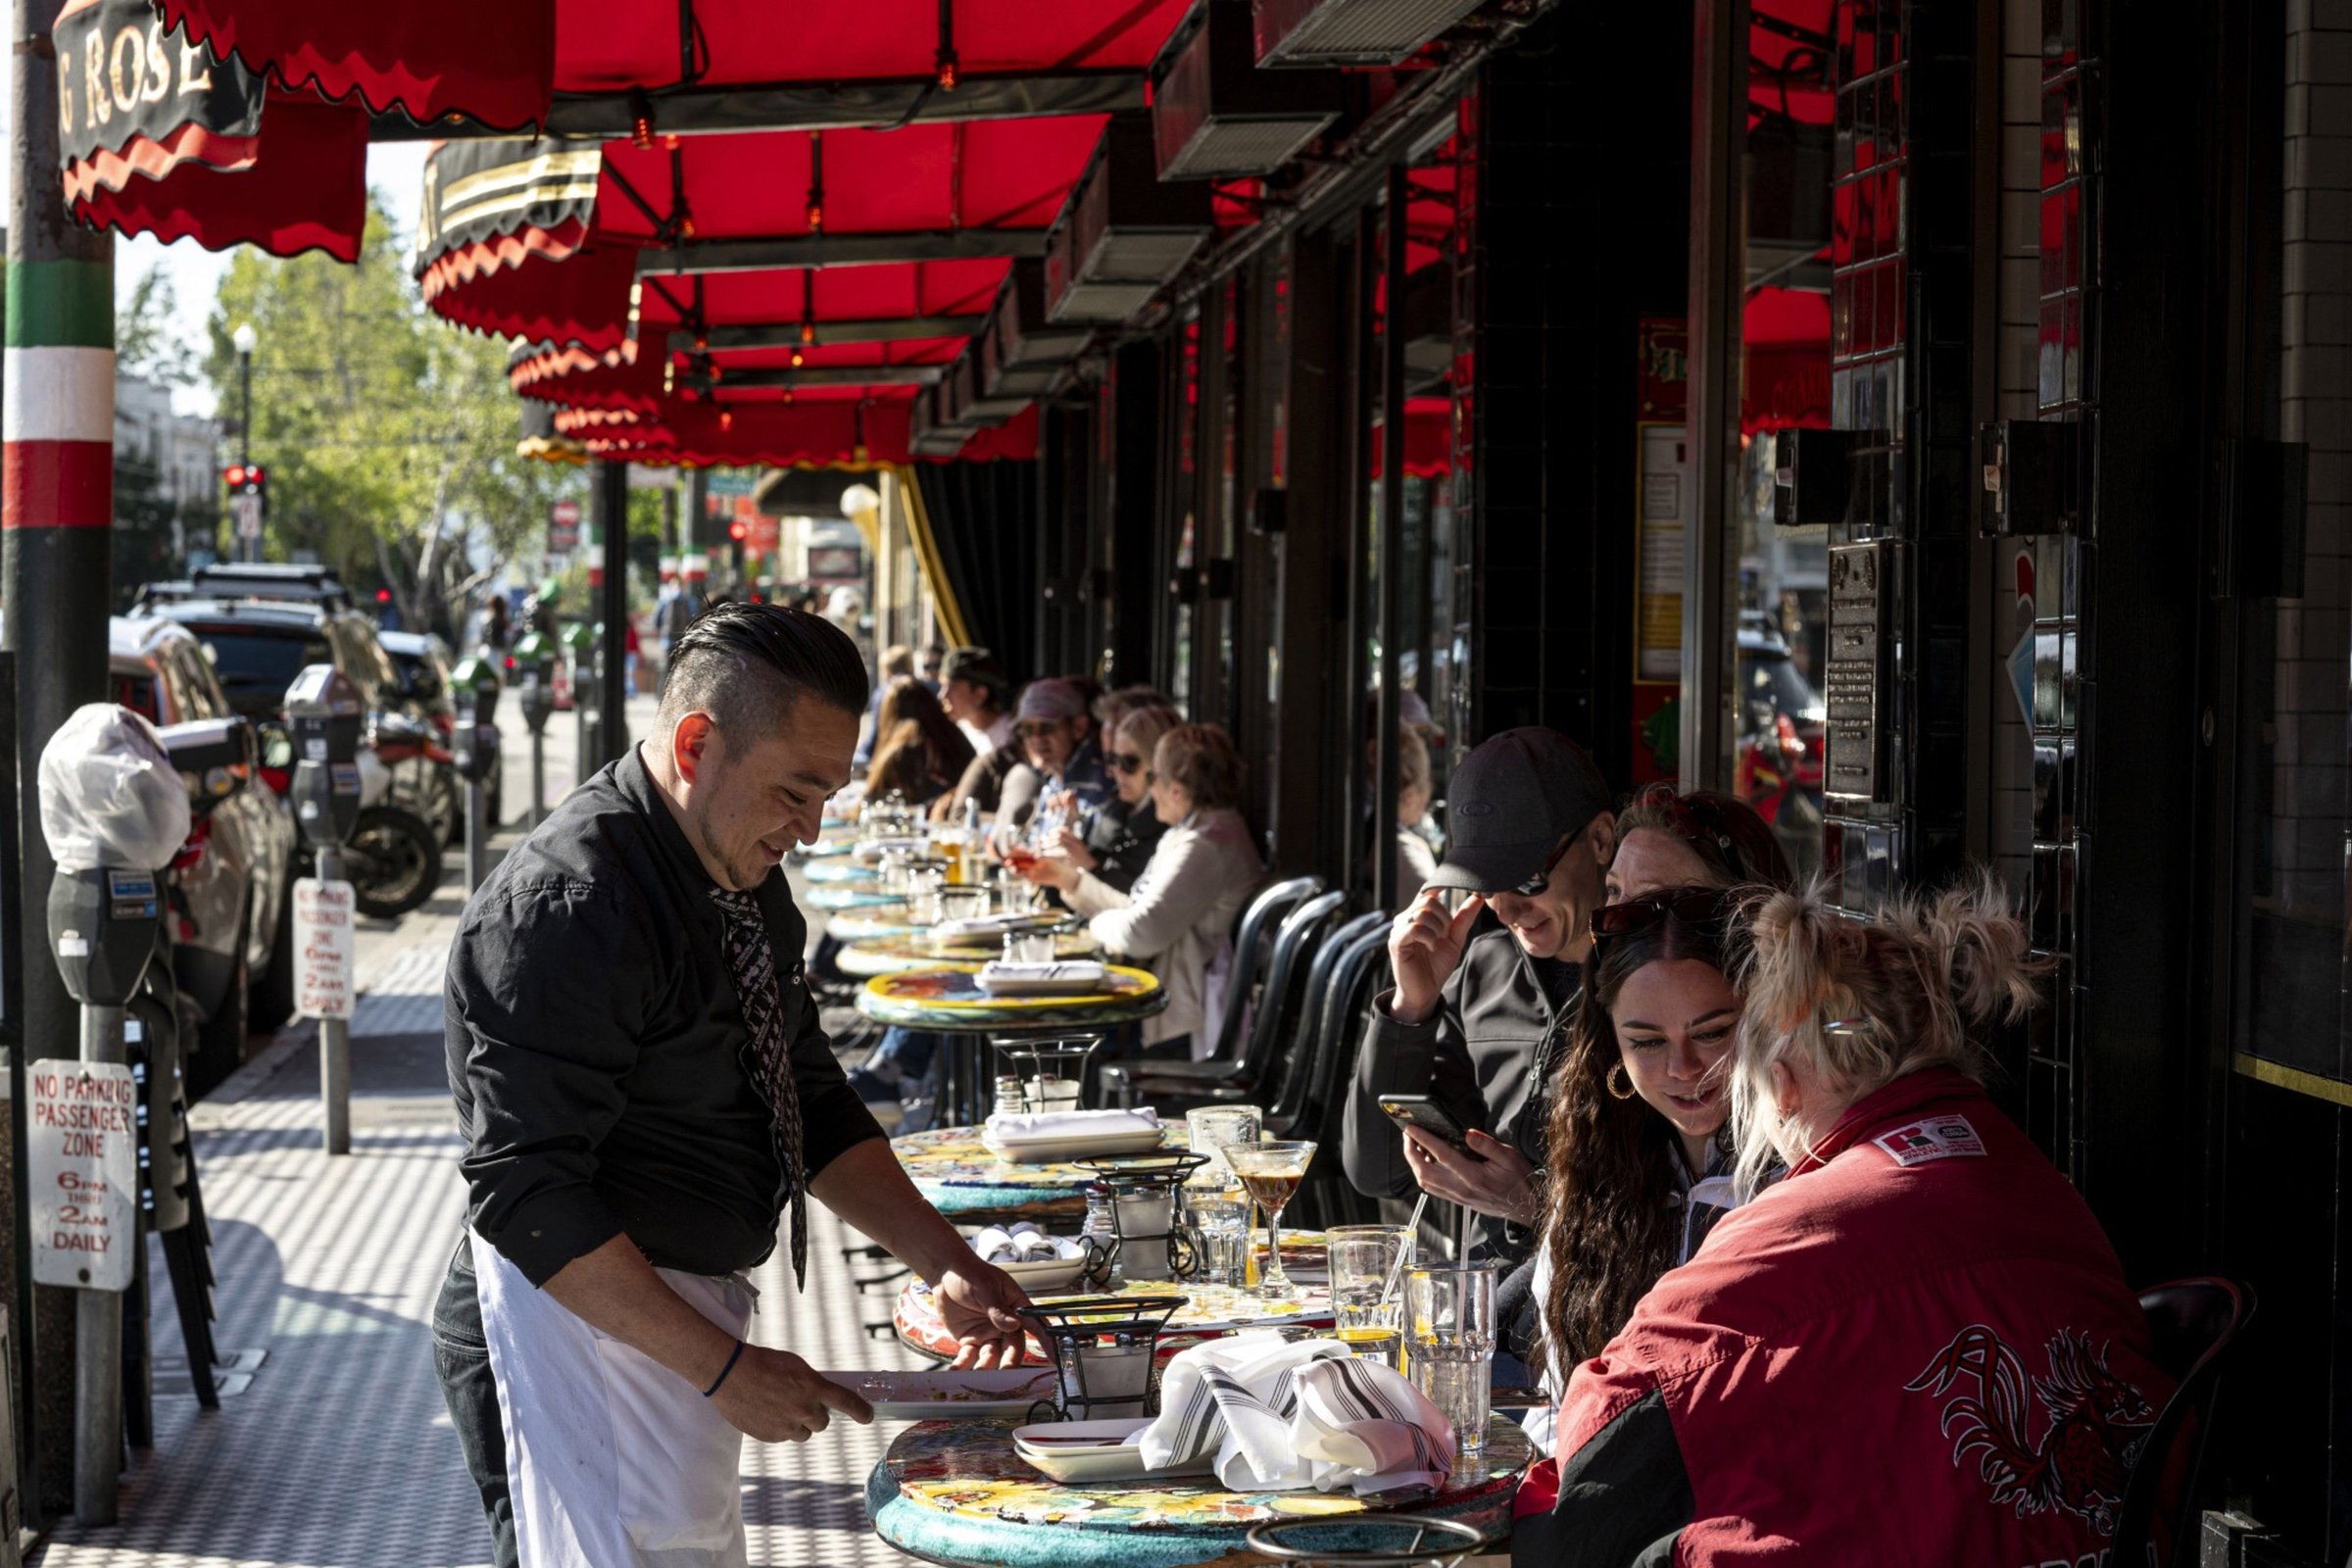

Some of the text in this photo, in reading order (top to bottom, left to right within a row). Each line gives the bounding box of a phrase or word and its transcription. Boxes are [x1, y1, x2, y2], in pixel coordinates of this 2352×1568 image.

[85, 17, 213, 130] ROSE
[34, 1073, 131, 1103] NO PARKING
[35, 1102, 130, 1132] PASSENGER
[62, 1131, 104, 1158] ZONE
[53, 1231, 112, 1252] DAILY
